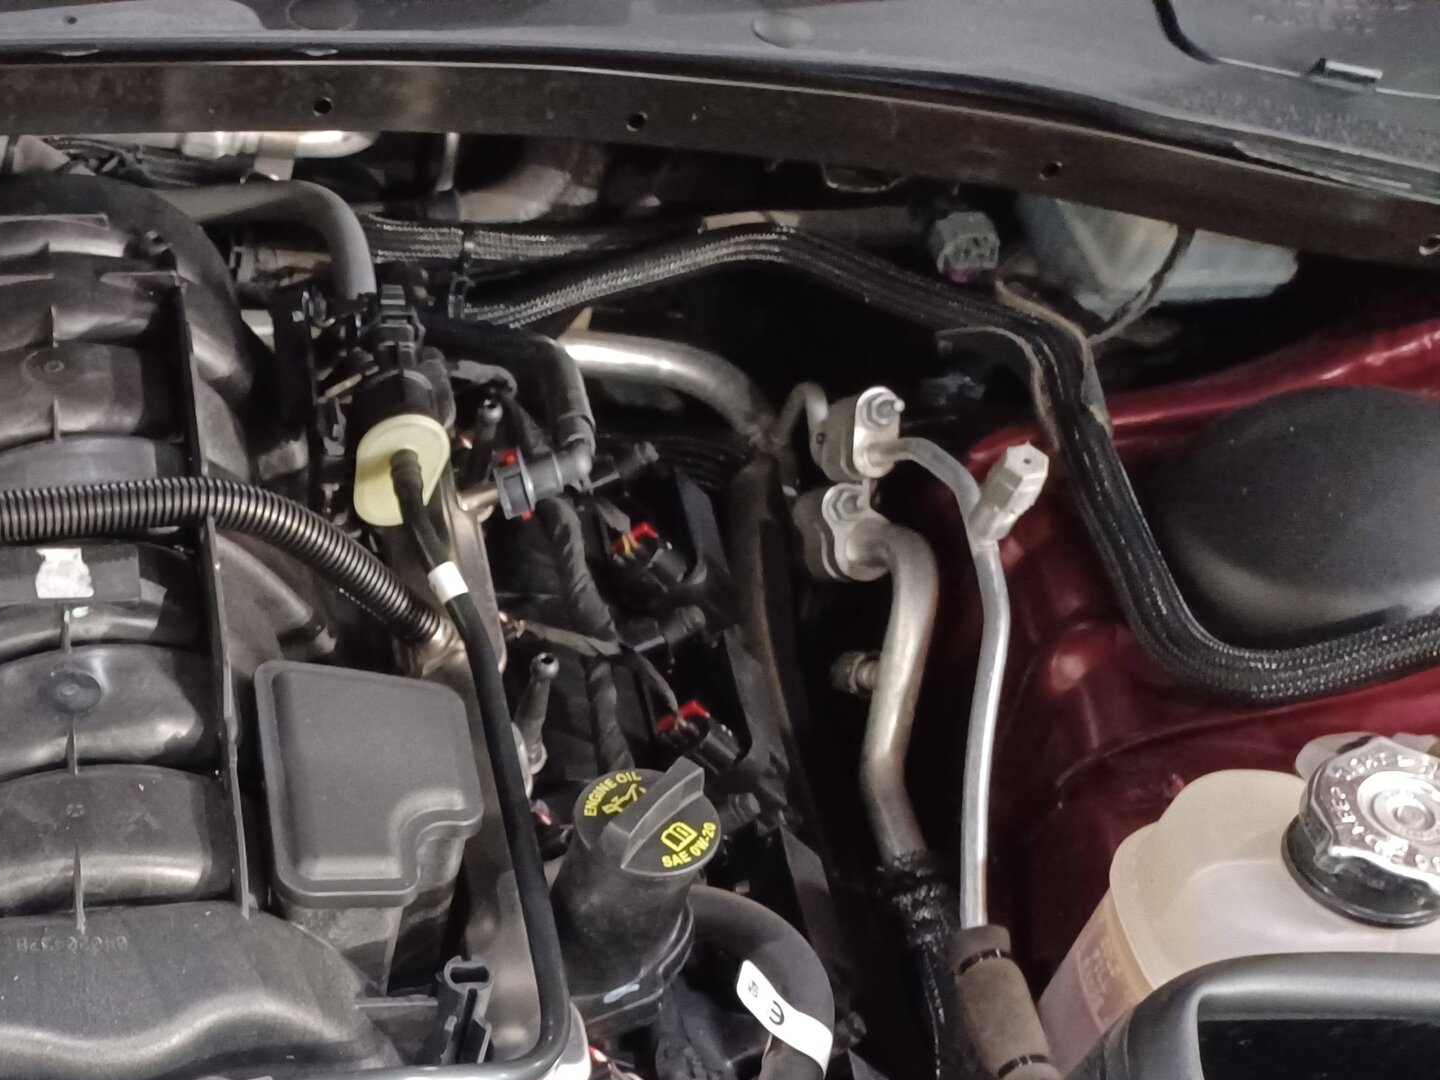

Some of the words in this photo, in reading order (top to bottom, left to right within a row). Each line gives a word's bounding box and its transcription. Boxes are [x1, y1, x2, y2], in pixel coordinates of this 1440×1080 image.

[583, 777, 618, 817] ENGINE
[615, 771, 643, 784] OIL
[661, 851, 692, 869] SAE
[689, 821, 717, 857] 0W-20
